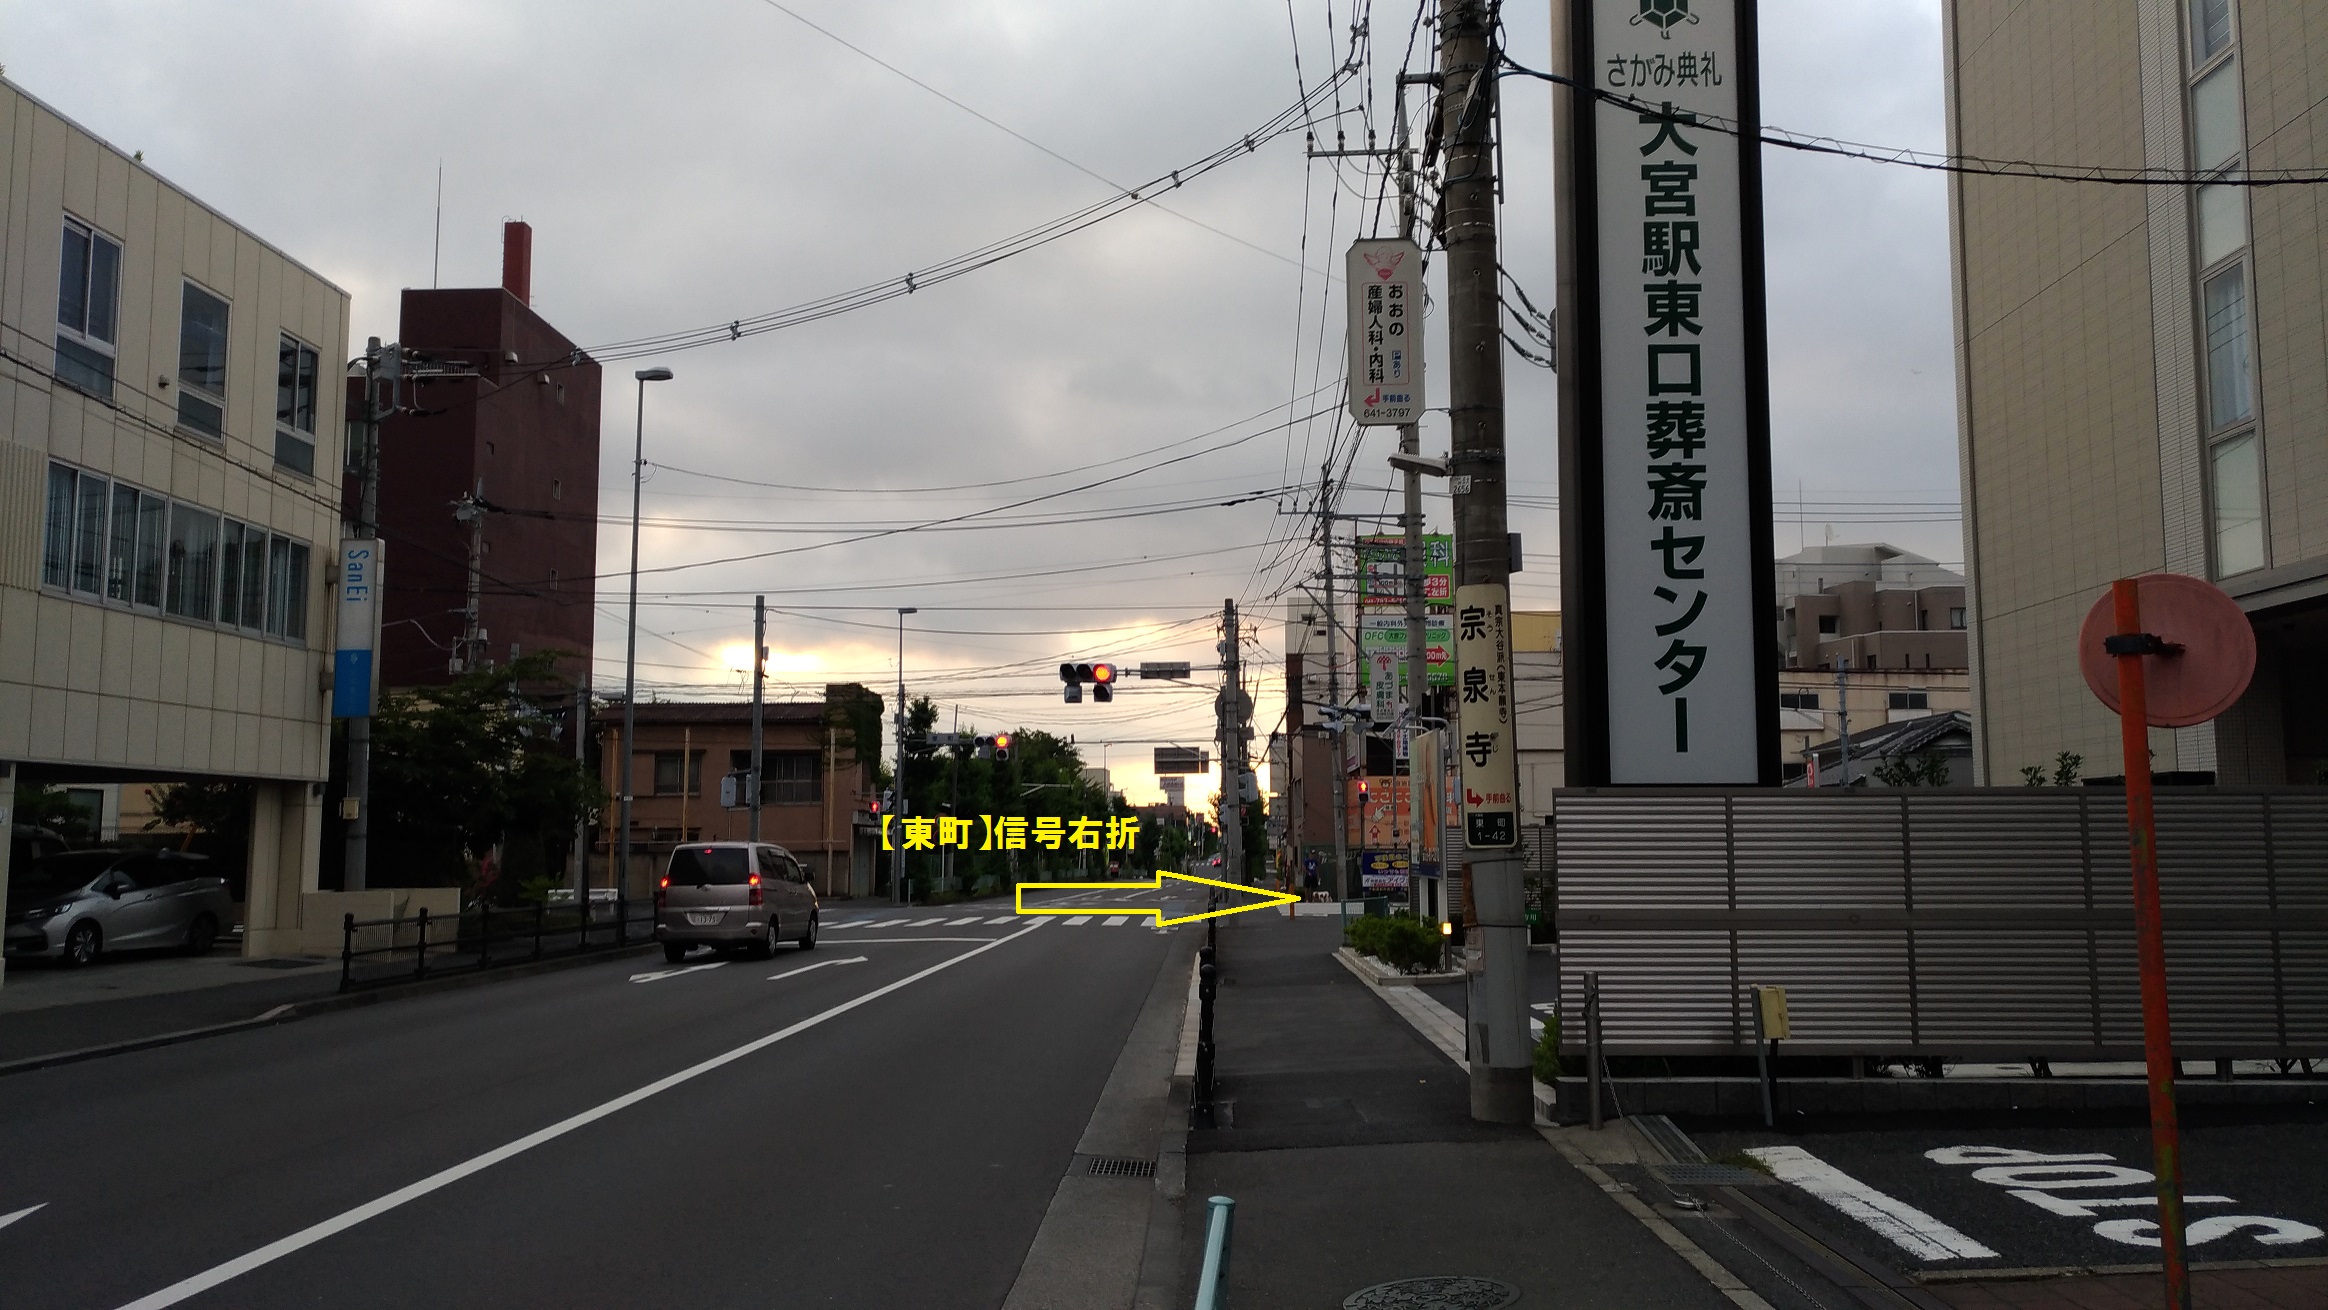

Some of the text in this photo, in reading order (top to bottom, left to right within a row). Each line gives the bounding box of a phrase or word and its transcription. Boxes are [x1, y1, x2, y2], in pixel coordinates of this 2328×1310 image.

[1607, 51, 1722, 88] さがみ典礼
[1367, 285, 1384, 383] 産婦人科・内科
[1388, 284, 1404, 336] おおの
[1363, 408, 1411, 418] 641-3797
[1638, 100, 1709, 754] 大宮駅東口葬斎センター
[347, 550, 370, 601] SanEi
[1364, 631, 1384, 641] OFC
[1460, 605, 1491, 768] 宗泉寺
[1477, 831, 1506, 841] 1-42
[1923, 1144, 2326, 1249] STOP
